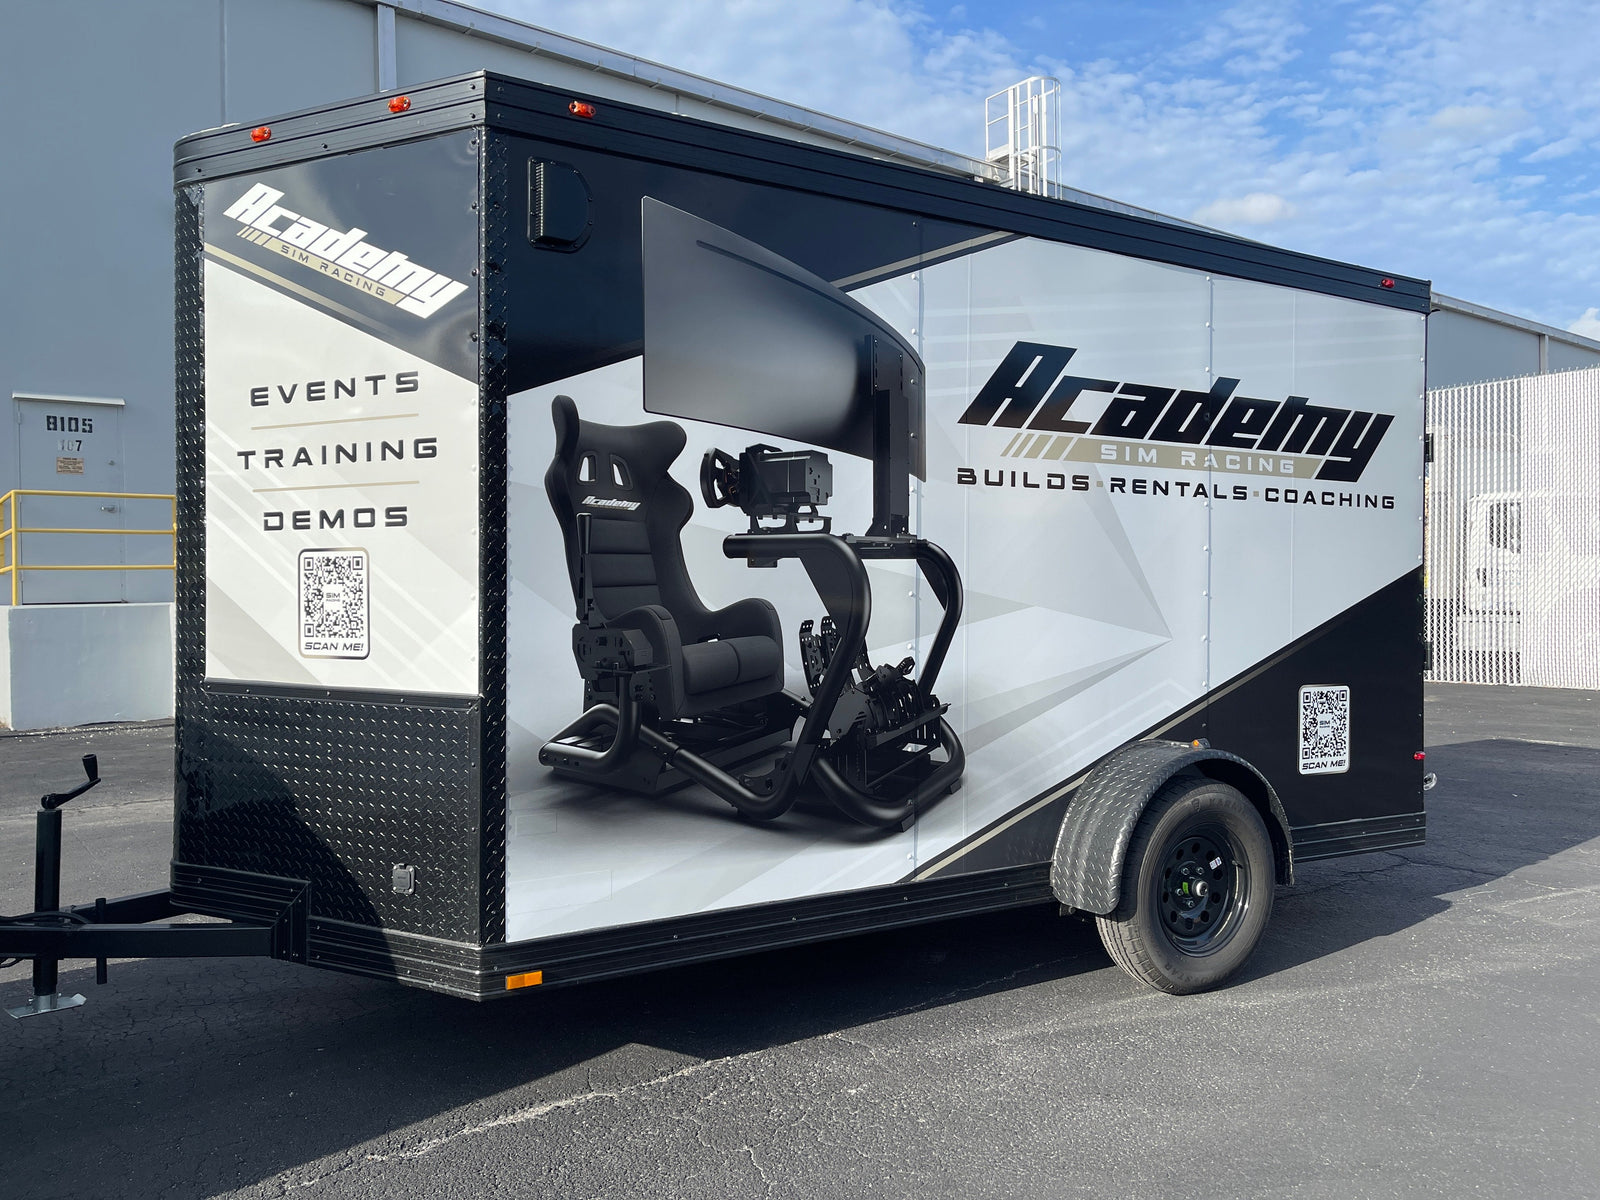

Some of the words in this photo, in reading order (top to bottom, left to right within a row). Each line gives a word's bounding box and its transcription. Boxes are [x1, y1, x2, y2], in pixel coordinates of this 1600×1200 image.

[223, 182, 469, 319] Academy
[281, 244, 310, 264] SIM
[319, 262, 386, 297] RACING
[250, 371, 419, 407] EVENTS
[957, 340, 1396, 483] Academy
[237, 437, 437, 470] TRAINING
[1100, 444, 1158, 464] SIM
[1180, 450, 1294, 475] RACING
[582, 495, 641, 511] Academy
[957, 467, 1090, 492] BUILDS
[1110, 477, 1248, 501] RENTALS
[1264, 487, 1395, 510] COACHING
[263, 506, 408, 532] DEMOS
[304, 642, 339, 651] SCAN
[342, 642, 364, 651] ME!
[1302, 761, 1328, 770] SCAN
[1330, 760, 1346, 768] ME!
